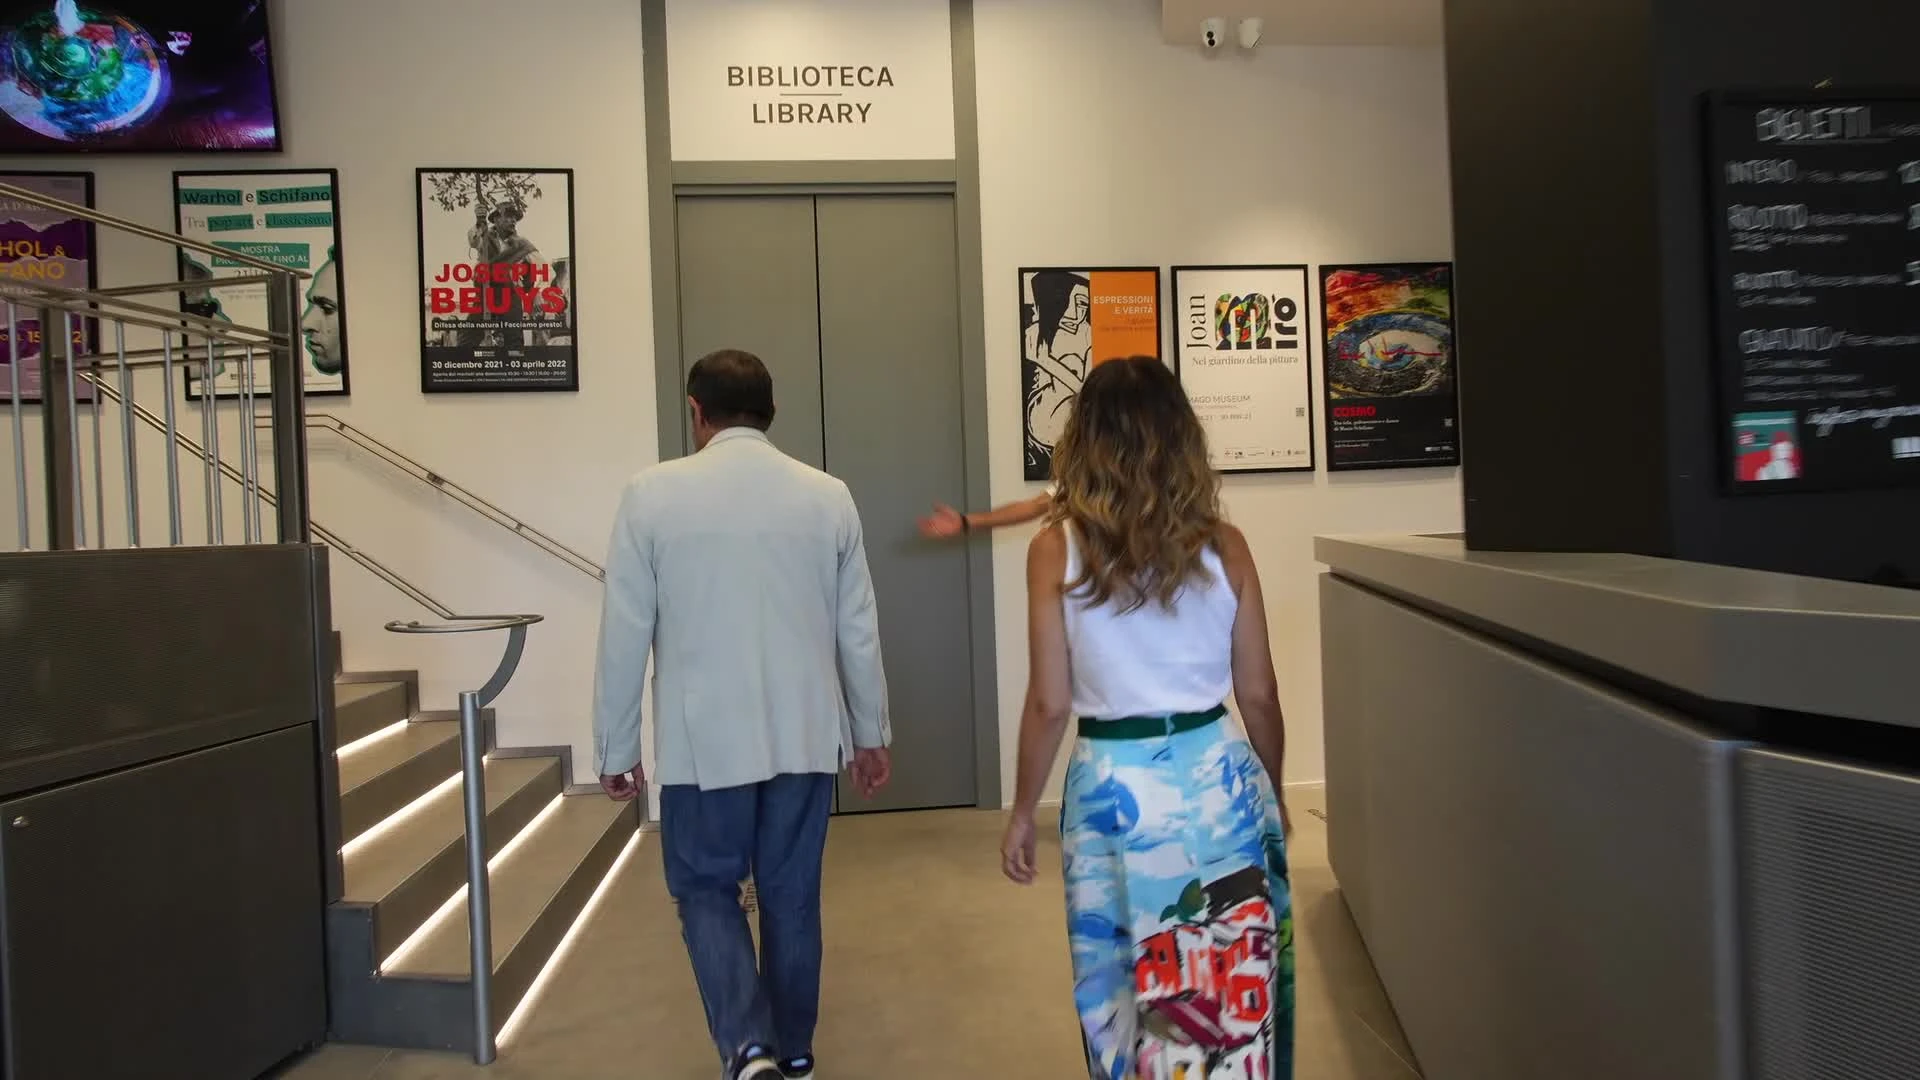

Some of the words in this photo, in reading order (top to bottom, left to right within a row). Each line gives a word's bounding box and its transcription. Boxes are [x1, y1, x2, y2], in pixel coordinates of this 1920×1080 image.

[727, 66, 895, 87] BIBLIOTECA
[752, 103, 872, 124] LIBRARY
[182, 190, 241, 204] Warhol
[246, 193, 254, 203] e
[258, 188, 331, 203] Schifano
[185, 216, 206, 228] Tra
[209, 218, 232, 231] pop
[235, 217, 253, 227] art
[256, 218, 263, 226] e
[266, 213, 331, 227] classicismo
[55, 244, 65, 257] &
[240, 245, 281, 254] MOSTRA
[273, 254, 296, 263] FINO
[297, 254, 309, 263] AL
[434, 263, 549, 283] JOSEPH
[430, 286, 567, 314] BEUYS
[1093, 295, 1153, 304] ESPRESSIONI
[1114, 306, 1121, 314] E
[1122, 304, 1153, 314] VERITÀ
[504, 321, 538, 329] Facciamo
[538, 321, 563, 330] presto!
[1186, 294, 1213, 350] Joan
[432, 361, 443, 369] 30
[444, 360, 483, 369] dicembre
[484, 360, 504, 369] 2021
[511, 360, 522, 368] 03
[523, 360, 546, 370] aprile
[547, 360, 567, 368] 2022
[1192, 356, 1208, 365] Nel
[1208, 355, 1246, 367] giardino
[1246, 354, 1268, 365] della
[1269, 354, 1299, 366] pittura
[1212, 394, 1251, 403] MUSEUM
[1333, 405, 1377, 418] COSMO
